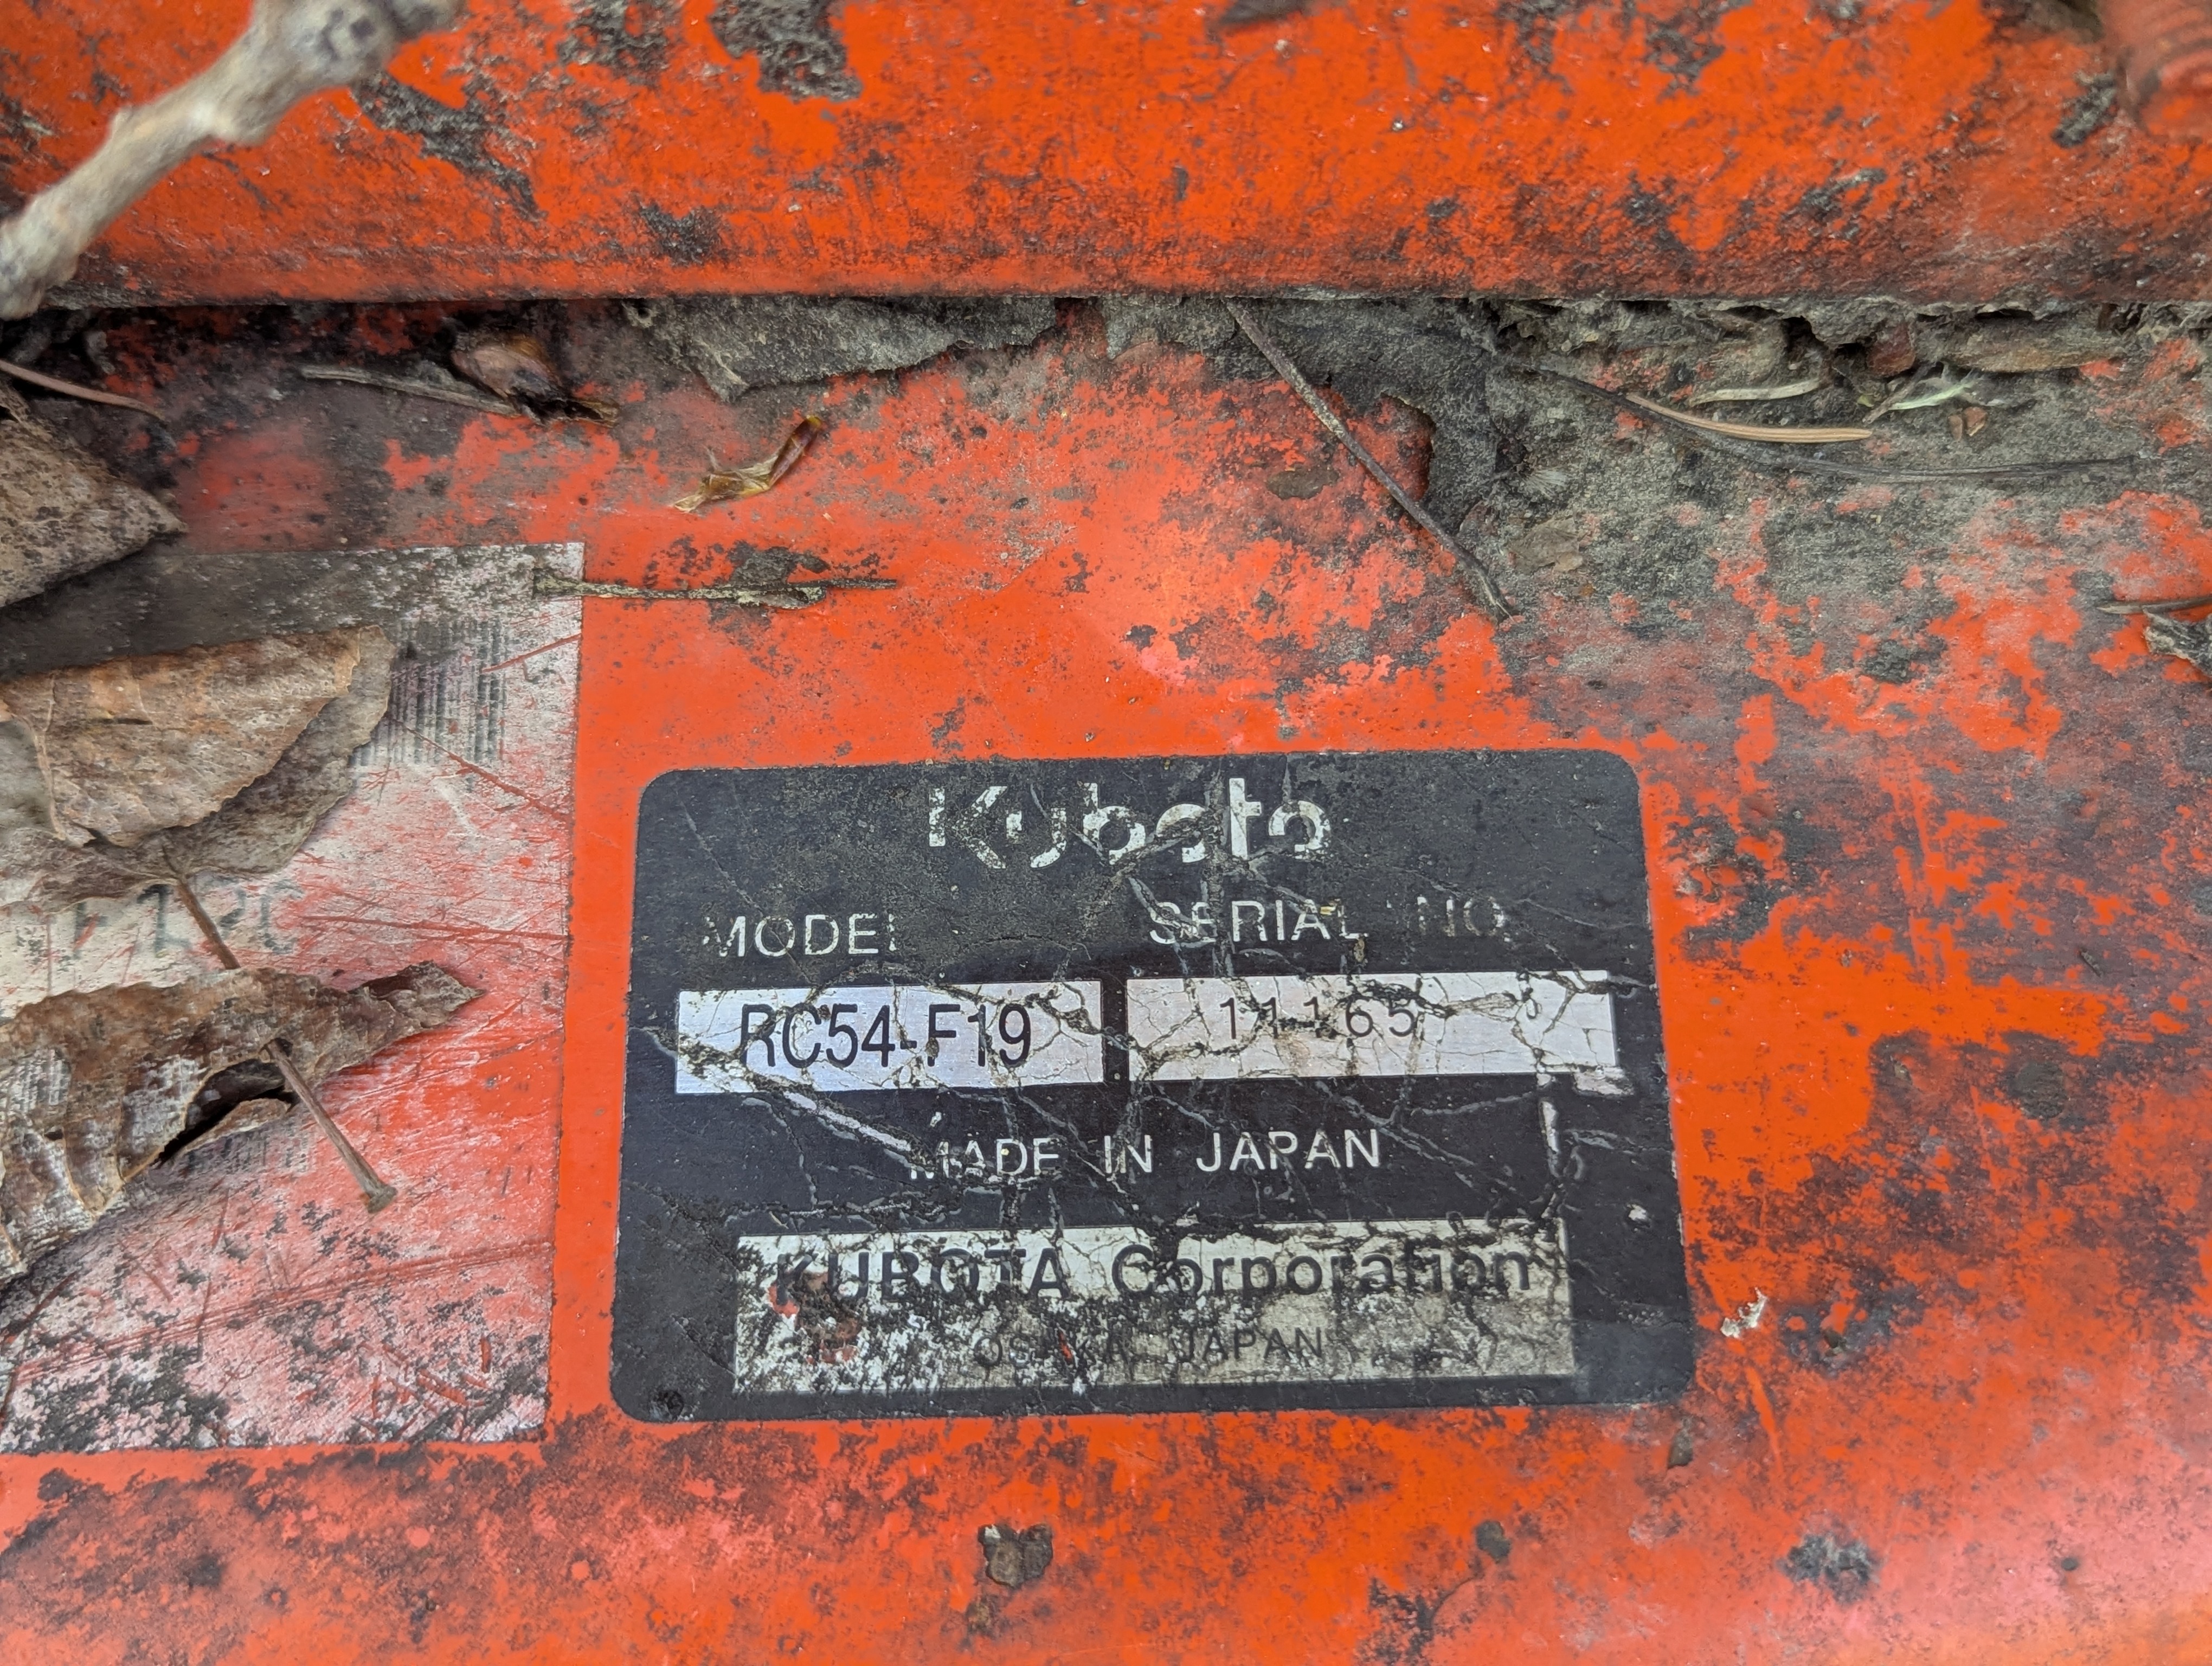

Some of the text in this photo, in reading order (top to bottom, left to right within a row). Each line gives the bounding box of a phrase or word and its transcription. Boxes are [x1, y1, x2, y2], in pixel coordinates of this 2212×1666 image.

[741, 1003, 1031, 1068] RC54-F19
[1220, 996, 1416, 1039] 11165
[1104, 1135, 1153, 1174] IN
[1196, 1129, 1380, 1172] JAPAN
